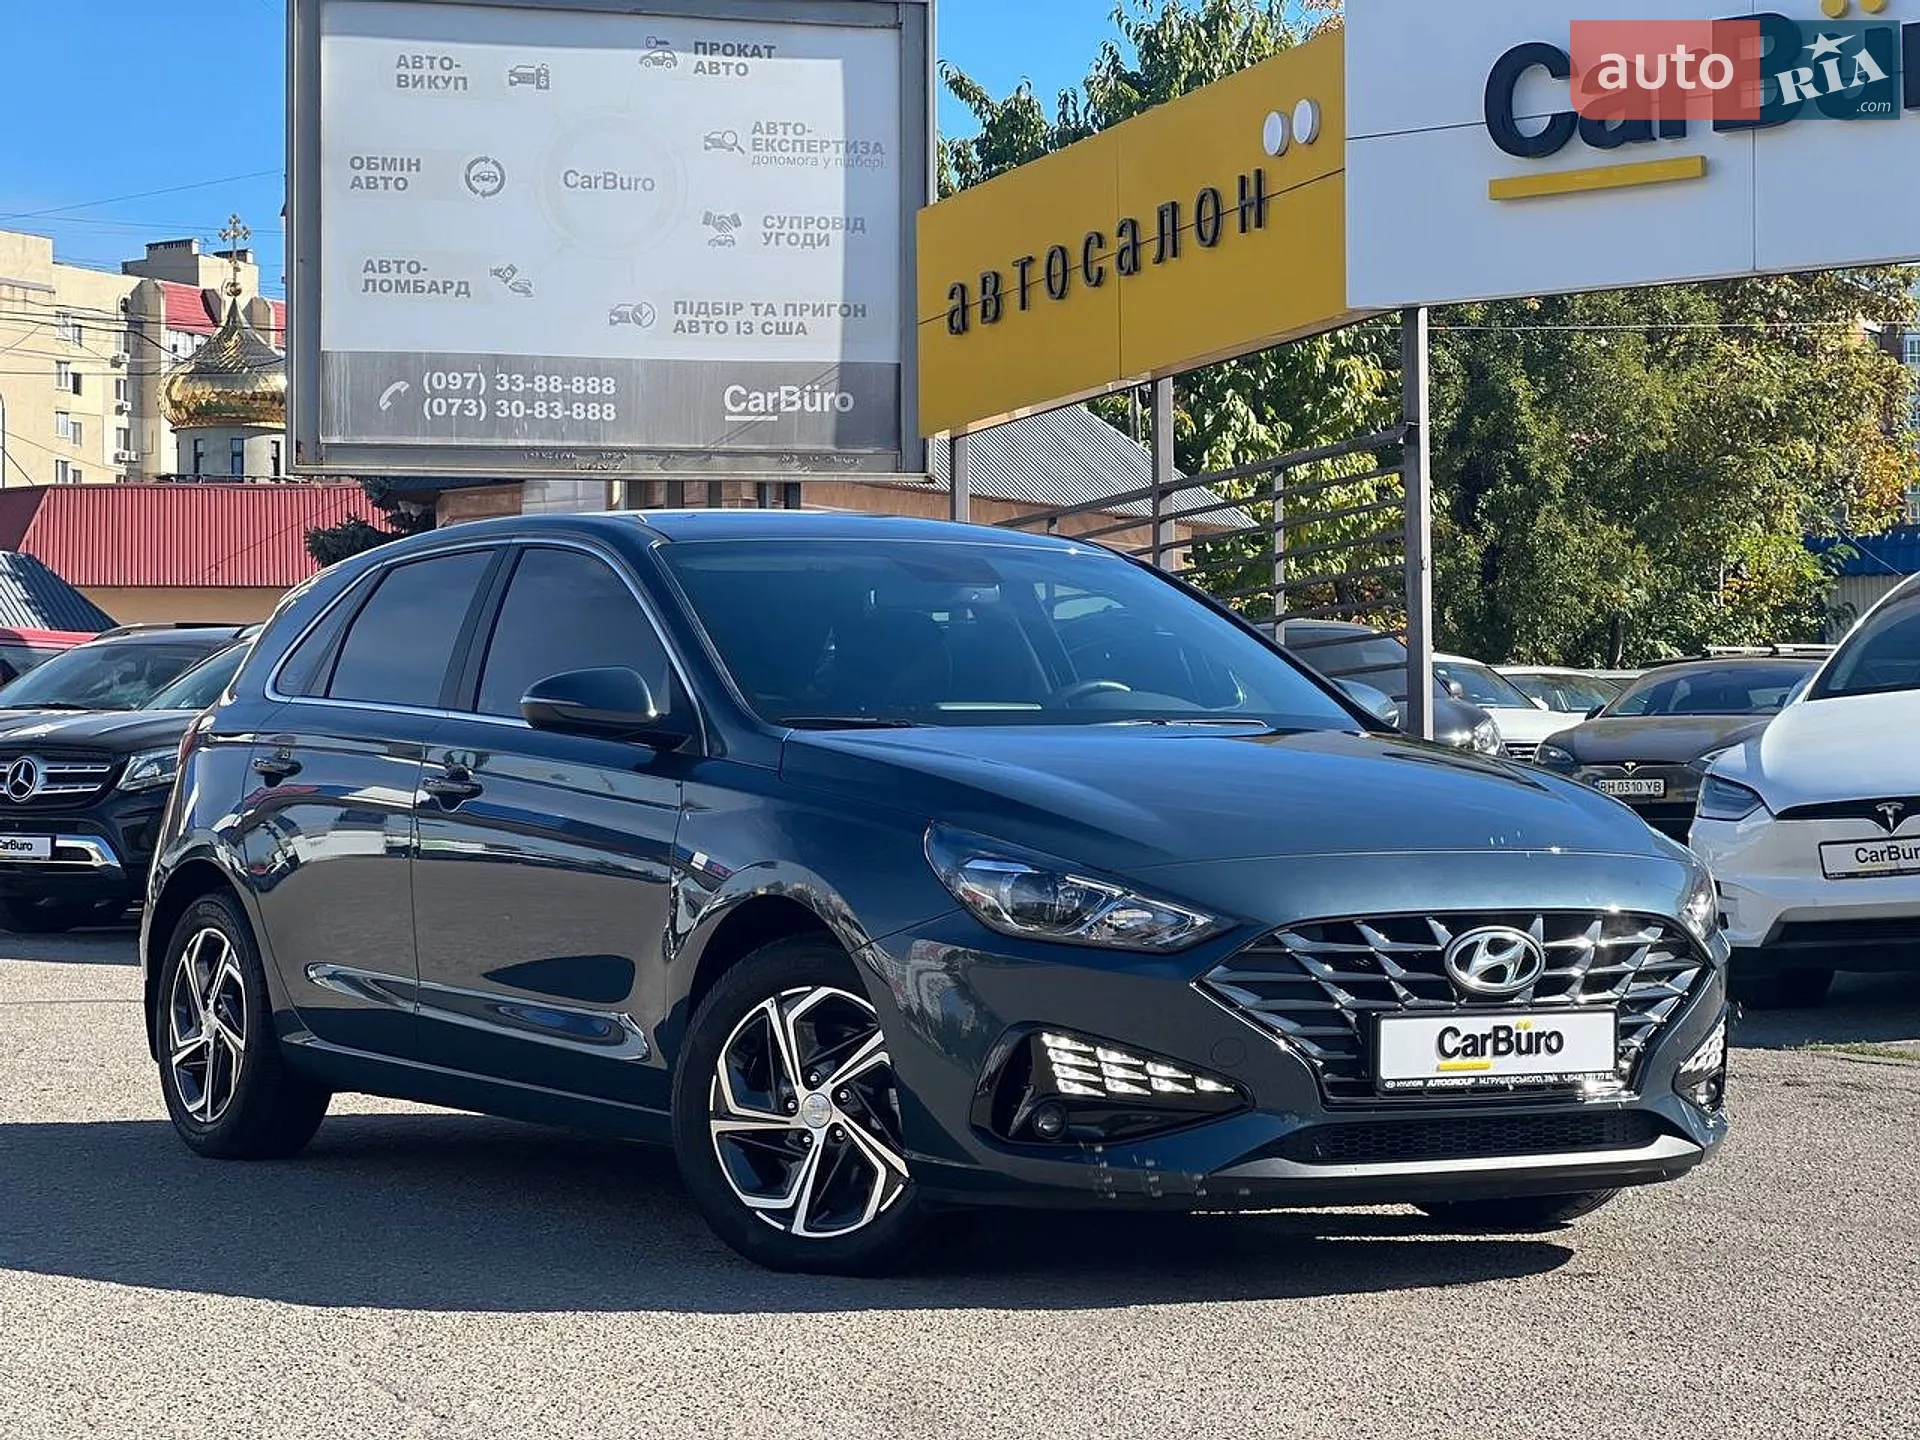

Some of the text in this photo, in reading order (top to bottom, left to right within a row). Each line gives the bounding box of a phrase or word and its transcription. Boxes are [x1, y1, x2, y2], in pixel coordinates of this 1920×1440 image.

[693, 41, 777, 59] ПРОКАТ
[396, 54, 462, 71] АВТО-
[693, 61, 750, 77] АВТО
[396, 74, 469, 91] ВИКУП
[751, 121, 813, 136] АВТО-
[751, 138, 886, 155] ЕКСПЕРТИЗА
[349, 156, 421, 173] ОБМІН
[751, 155, 819, 167] допомога
[823, 156, 832, 169] у
[349, 176, 409, 192] АВТО
[763, 215, 867, 234] СУПРОВІД
[763, 232, 831, 249] УГОДИ
[946, 168, 1268, 336] автосалон
[363, 259, 429, 275] АВТО-
[361, 278, 472, 299] ЛОМБАРД
[673, 301, 867, 319] ПІДБІР ТА ПРИГОН
[672, 321, 808, 337] АВТО ІЗ США
[422, 371, 617, 395] (097) 33-88-888
[724, 384, 855, 413] CarBüro
[422, 397, 617, 422] (073) 30-83-888
[1617, 781, 1643, 793] 0310
[1437, 1019, 1564, 1058] CarBüro
